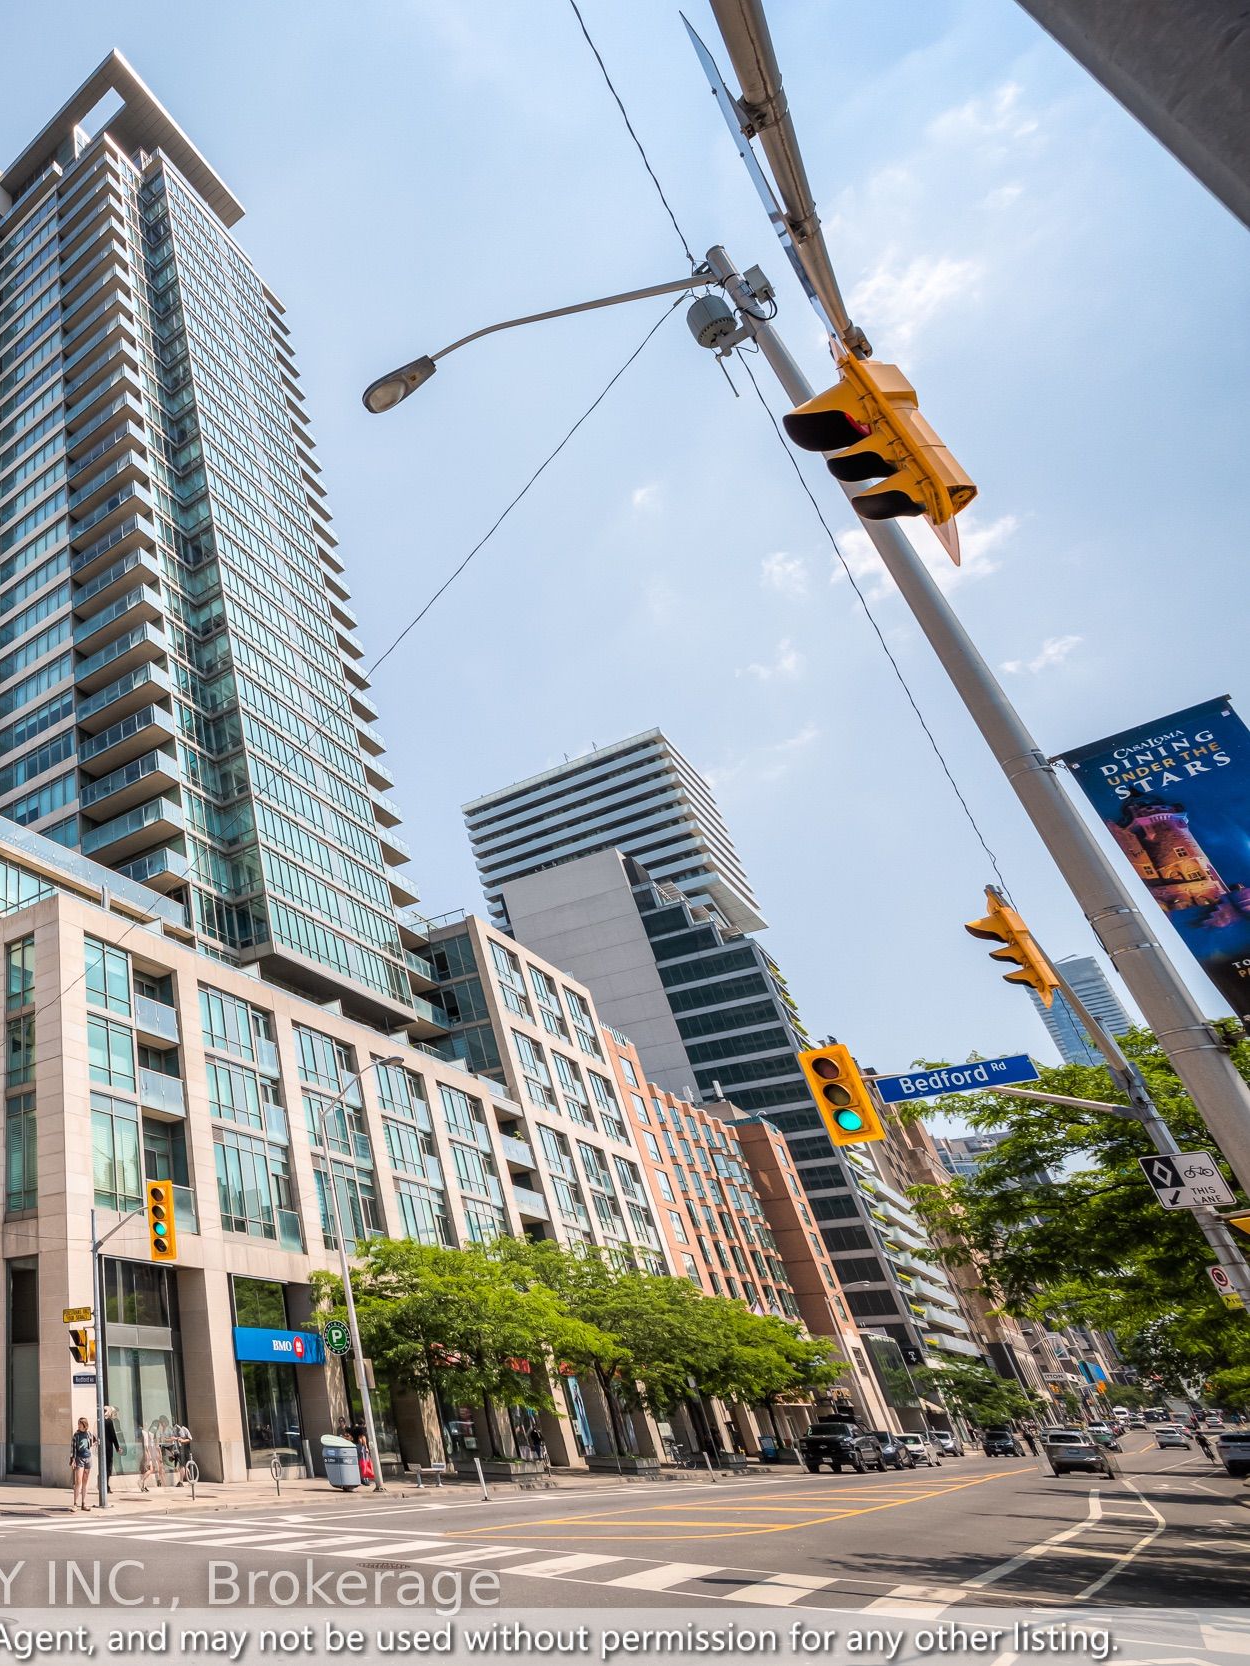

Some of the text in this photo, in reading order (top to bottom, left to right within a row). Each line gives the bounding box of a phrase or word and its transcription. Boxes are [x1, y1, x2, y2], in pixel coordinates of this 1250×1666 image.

[1099, 730, 1214, 776] DINING
[1107, 741, 1221, 786] UNDER THE
[1114, 751, 1231, 800] STARS
[899, 1061, 1007, 1094] Bedford Rd
[1191, 1186, 1216, 1195] THIS
[1193, 1194, 1223, 1203] LANE
[272, 1339, 293, 1352] BMO
